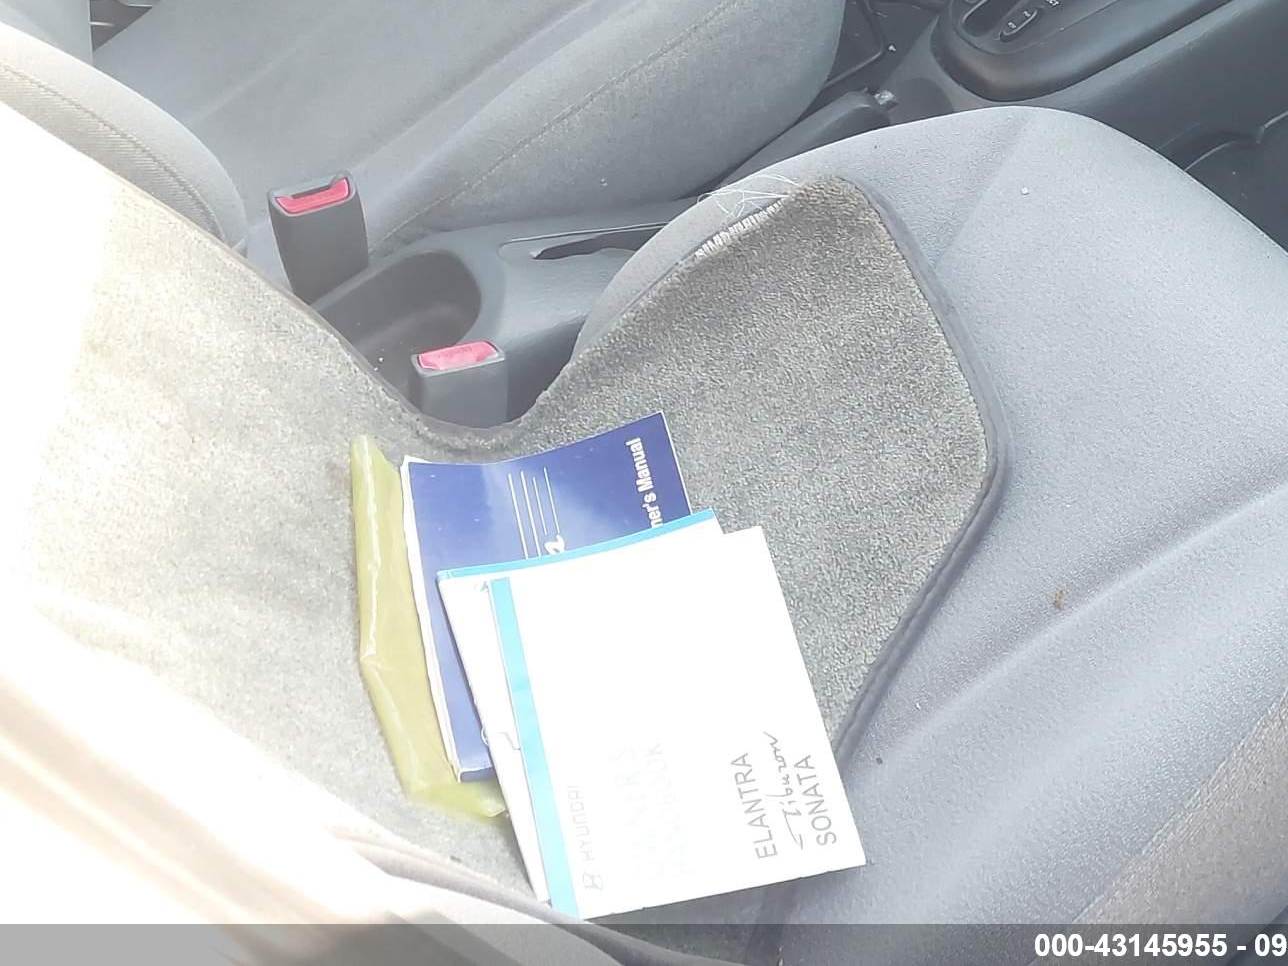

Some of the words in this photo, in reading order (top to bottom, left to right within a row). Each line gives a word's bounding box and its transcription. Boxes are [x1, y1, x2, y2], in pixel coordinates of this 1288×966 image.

[626, 437, 654, 493] Manual
[642, 492, 664, 529] ner's
[731, 752, 778, 860] ELANTRA
[794, 754, 838, 847] SONATA
